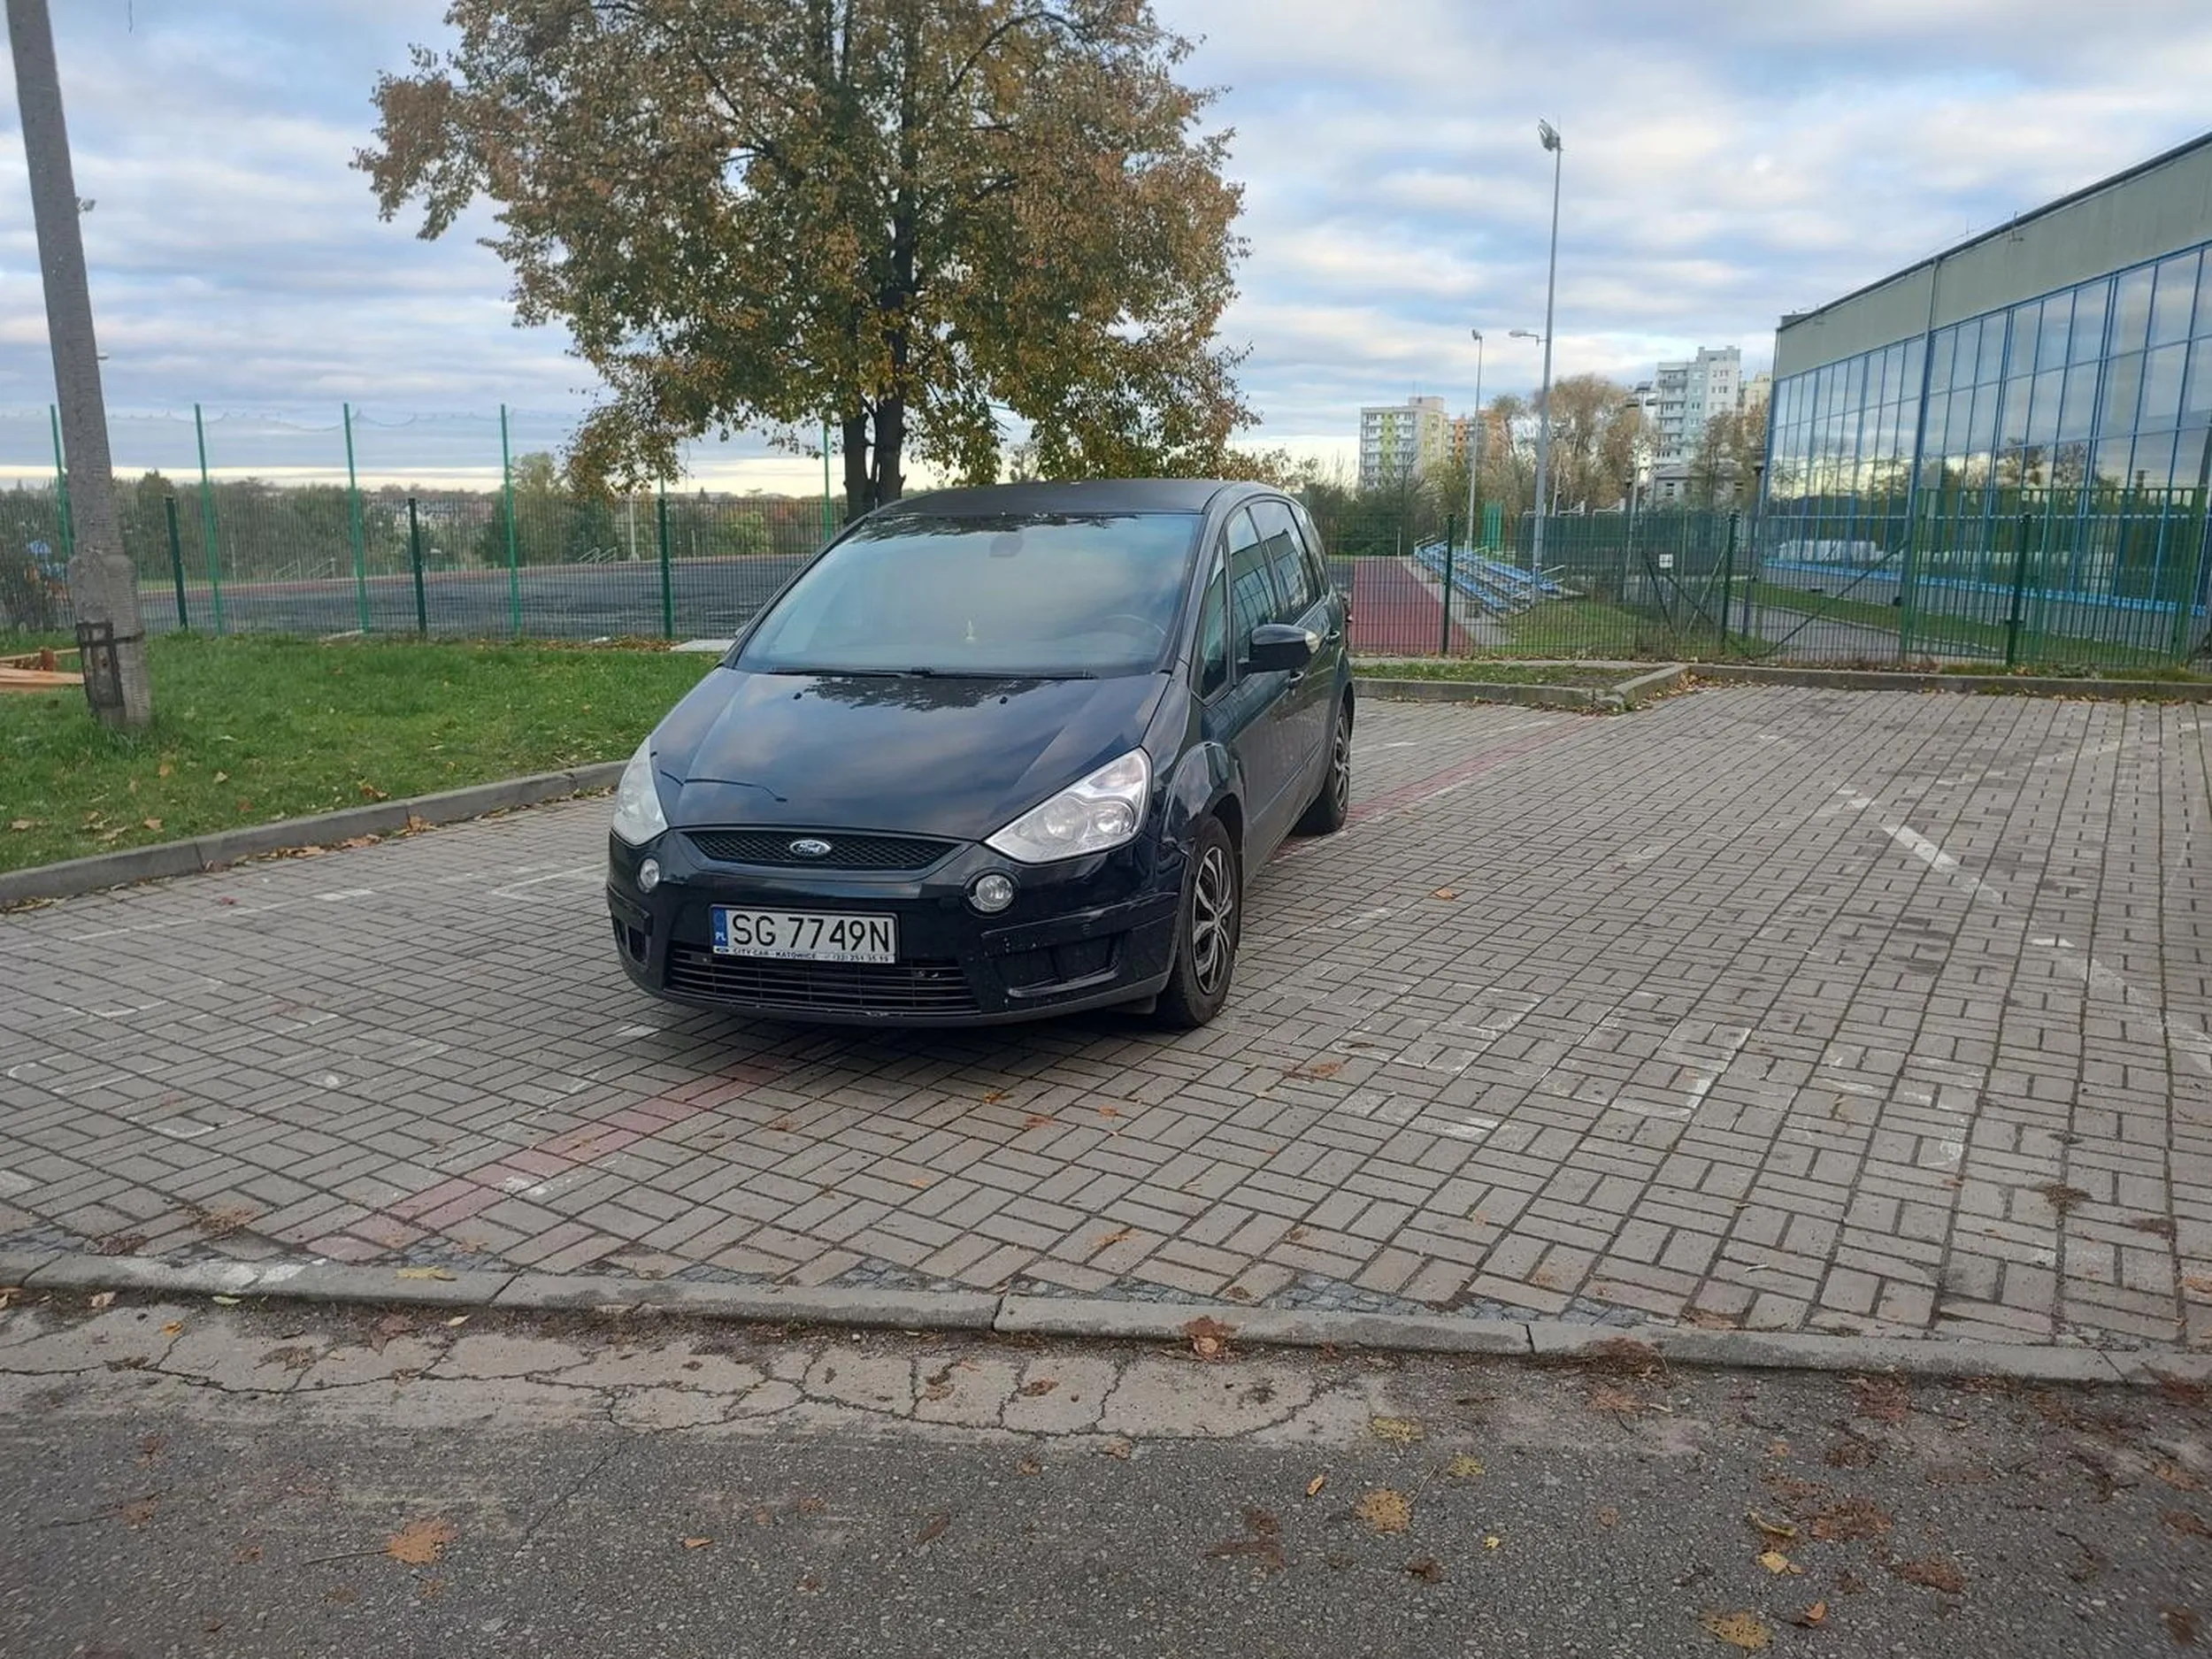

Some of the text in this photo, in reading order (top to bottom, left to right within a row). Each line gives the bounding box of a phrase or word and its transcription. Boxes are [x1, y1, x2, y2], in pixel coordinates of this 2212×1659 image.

[715, 931, 726, 941] PL
[733, 914, 889, 953] SG 7749N
